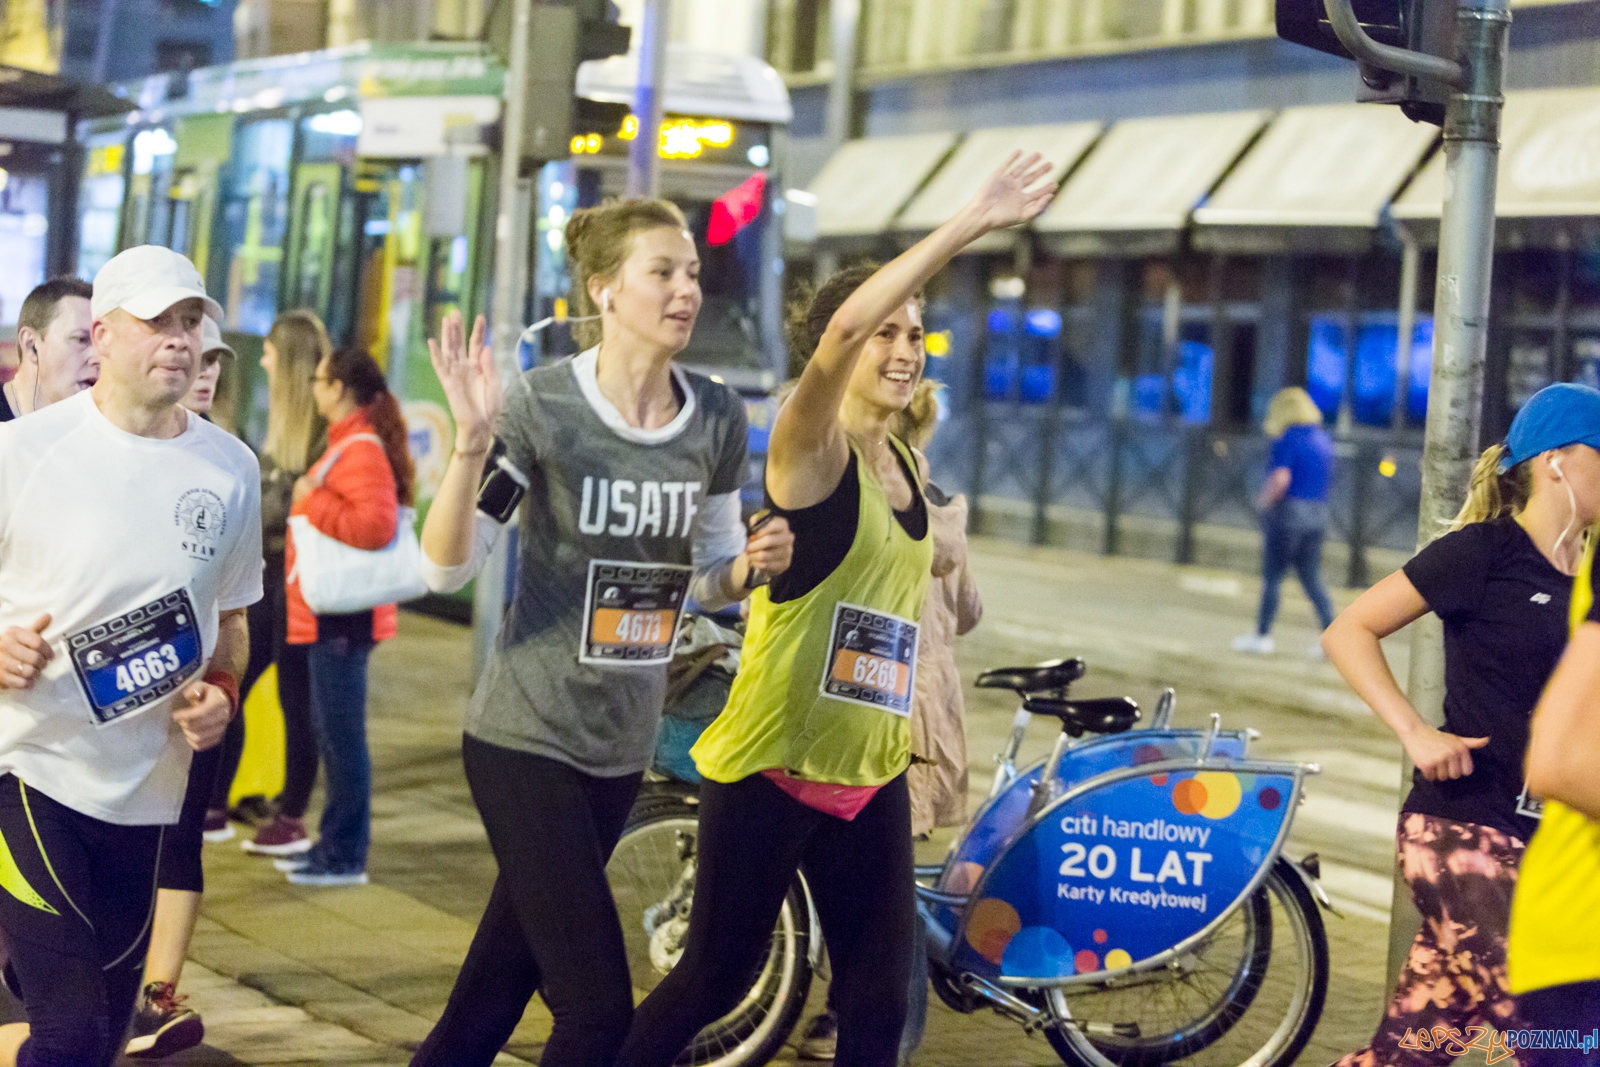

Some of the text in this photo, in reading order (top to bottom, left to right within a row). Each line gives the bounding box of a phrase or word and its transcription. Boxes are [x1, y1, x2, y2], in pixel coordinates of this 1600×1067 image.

[578, 476, 702, 538] USATF
[615, 612, 661, 643] 4673
[116, 643, 180, 693] 4663
[853, 655, 898, 692] 6269
[1060, 813, 1211, 849] citi handlowy
[1058, 842, 1213, 887] 20 LAT
[1057, 882, 1208, 913] Karty Kredytowej
